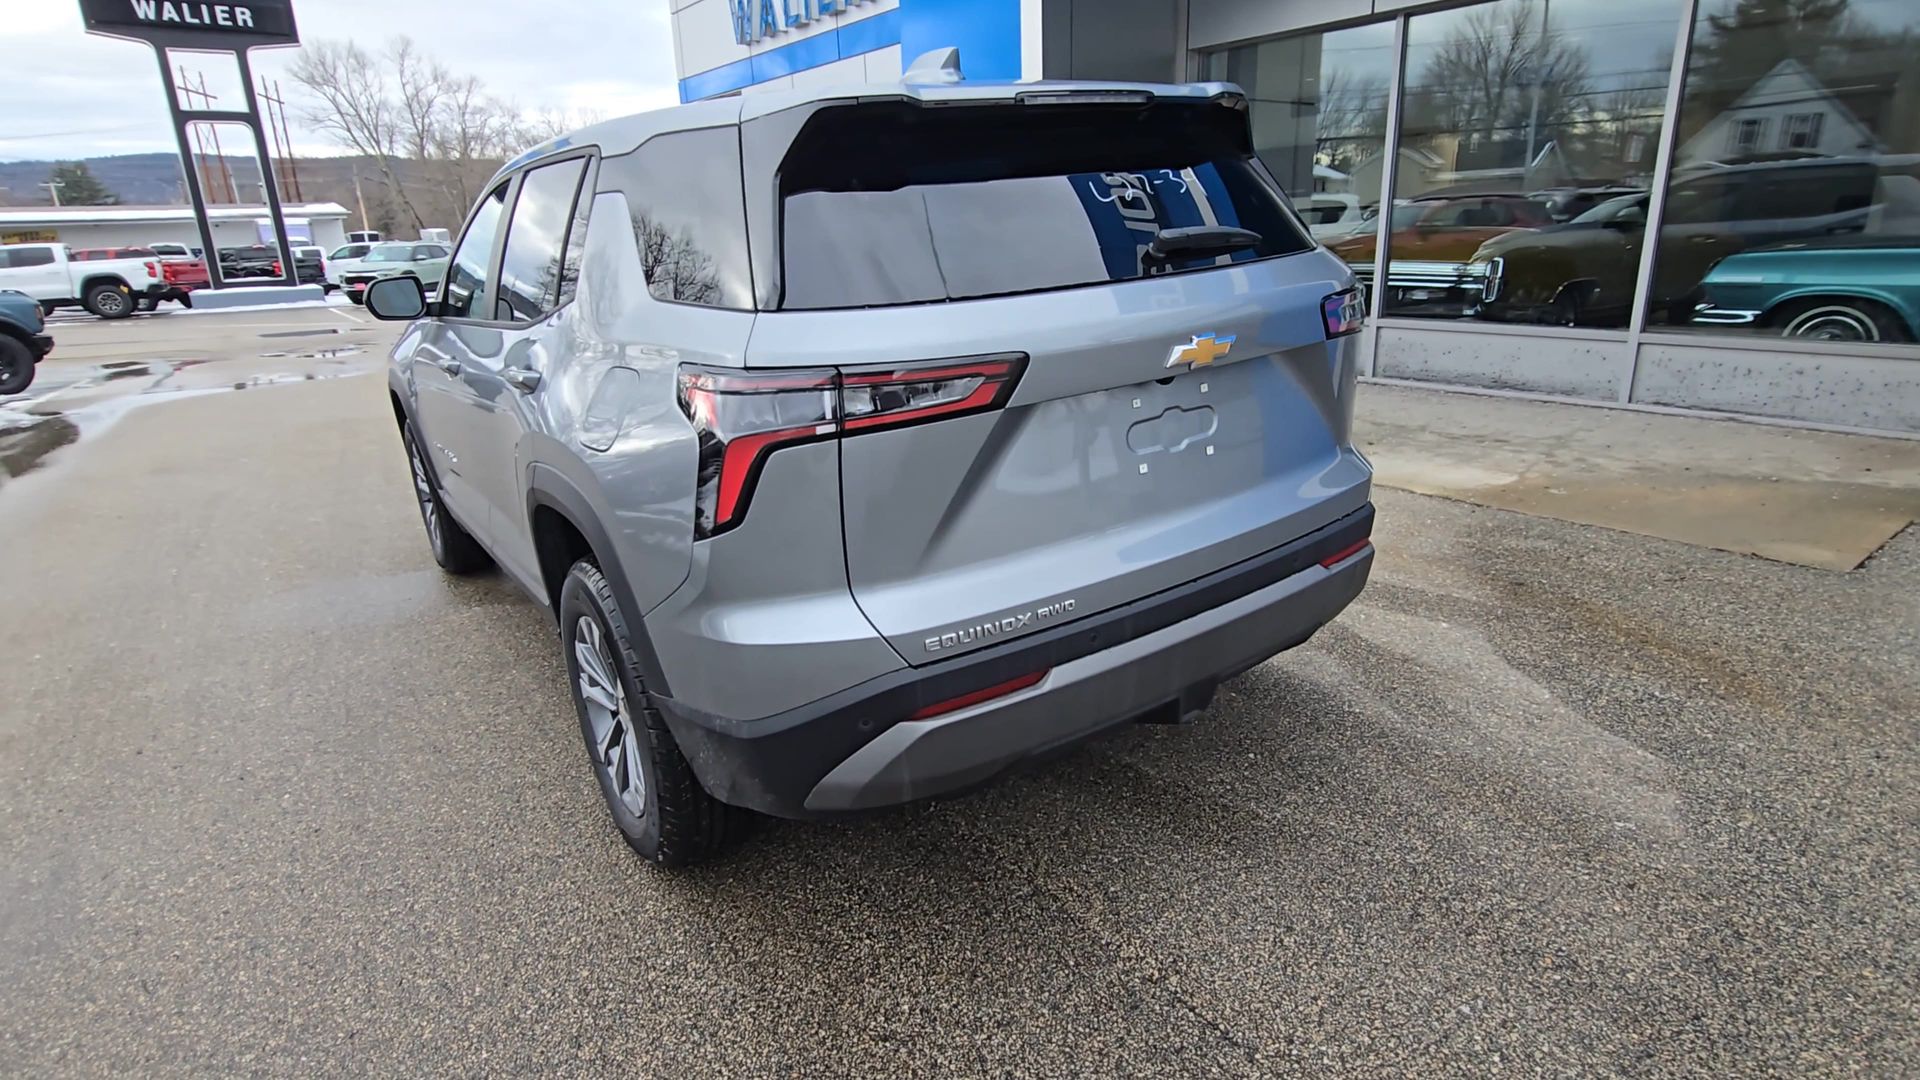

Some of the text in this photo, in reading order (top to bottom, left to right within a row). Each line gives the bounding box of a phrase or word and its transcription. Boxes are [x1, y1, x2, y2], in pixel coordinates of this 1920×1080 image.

[130, 0, 254, 28] WALIER
[727, 0, 877, 46] WALI
[924, 599, 1076, 652] EQUINOX AWD
